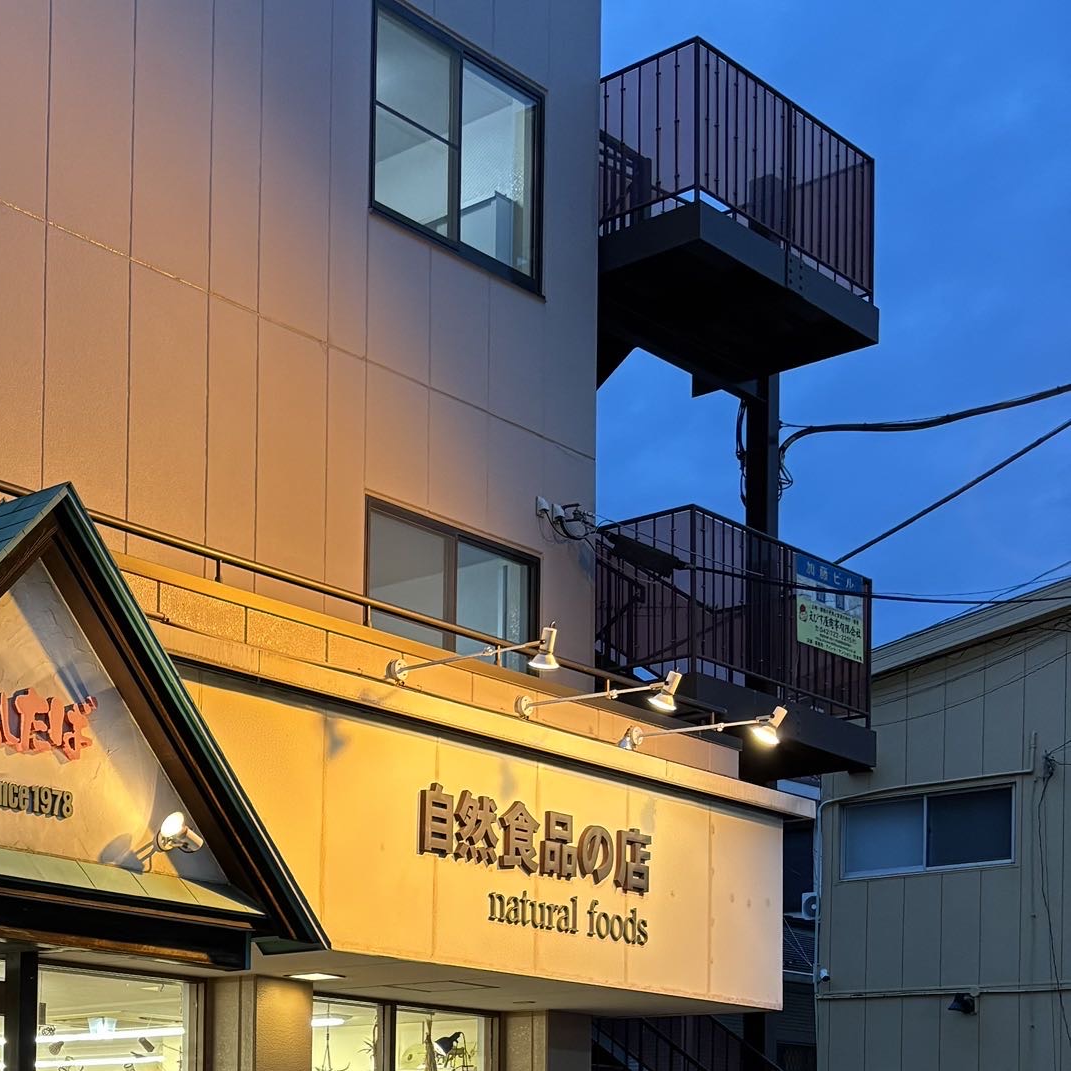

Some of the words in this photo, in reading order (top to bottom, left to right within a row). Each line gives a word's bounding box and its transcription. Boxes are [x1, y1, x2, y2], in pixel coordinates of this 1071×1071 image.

[806, 562, 855, 589] 加藤ビル
[417, 782, 652, 896] 自然食品の店
[487, 890, 579, 935] natural
[586, 899, 649, 946] foods
